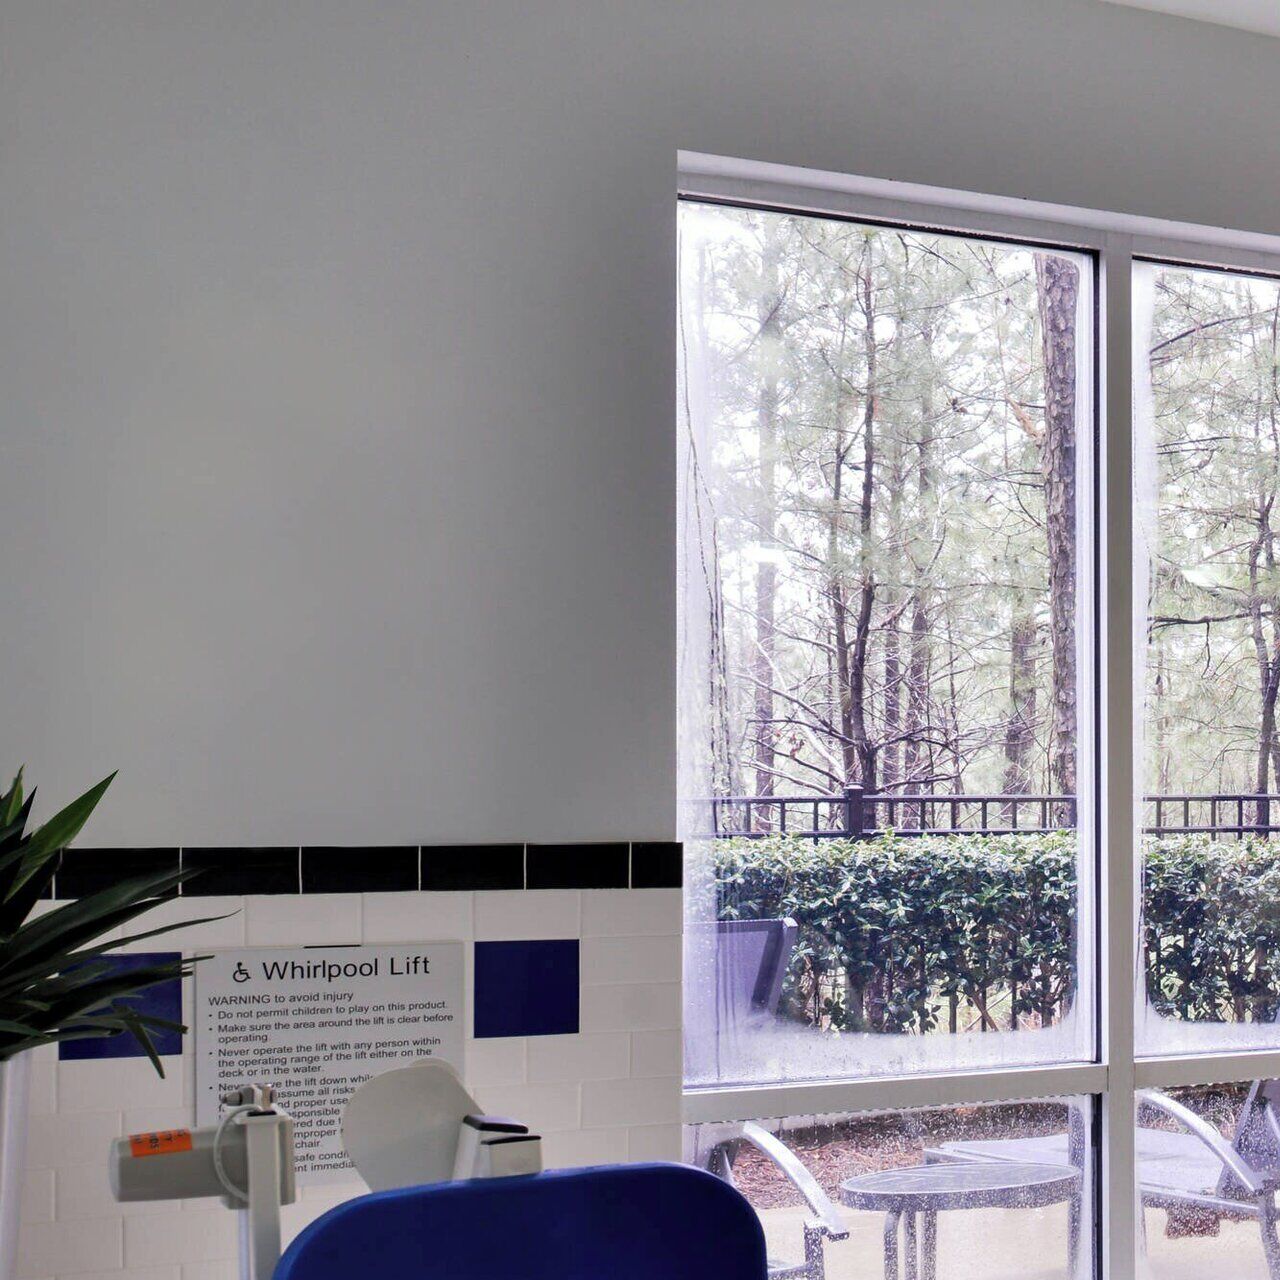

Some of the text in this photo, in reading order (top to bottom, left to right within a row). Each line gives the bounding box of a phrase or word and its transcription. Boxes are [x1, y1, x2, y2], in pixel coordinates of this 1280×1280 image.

[262, 956, 430, 982] Whirlpool Lift
[208, 991, 354, 1007] WARNING to avoid injury
[218, 1010, 233, 1020] Do
[236, 1010, 253, 1019] not
[256, 1008, 289, 1019] permit
[292, 1007, 332, 1016] children
[336, 1006, 345, 1014] to
[348, 1004, 370, 1015] play
[388, 1002, 406, 1012] this
[218, 1013, 453, 1033] Make sure the area around the lift is clear before
[218, 1037, 441, 1057] Never operate the lift with any person within
[218, 1048, 432, 1068] the operating range of the lift either on the
[218, 1069, 243, 1078] deck
[261, 1067, 270, 1075] in
[274, 1066, 290, 1075] the
[218, 1083, 241, 1092] Nev
[285, 1079, 300, 1088] the
[304, 1078, 316, 1086] lift
[319, 1076, 347, 1085] down
[350, 1074, 374, 1084] whil
[277, 1086, 355, 1098] ssume all risks
[277, 1100, 290, 1109] nd
[293, 1099, 326, 1110] proper
[288, 1107, 340, 1119] sponsible
[316, 1119, 335, 1127] due
[293, 1130, 336, 1140] mproper
